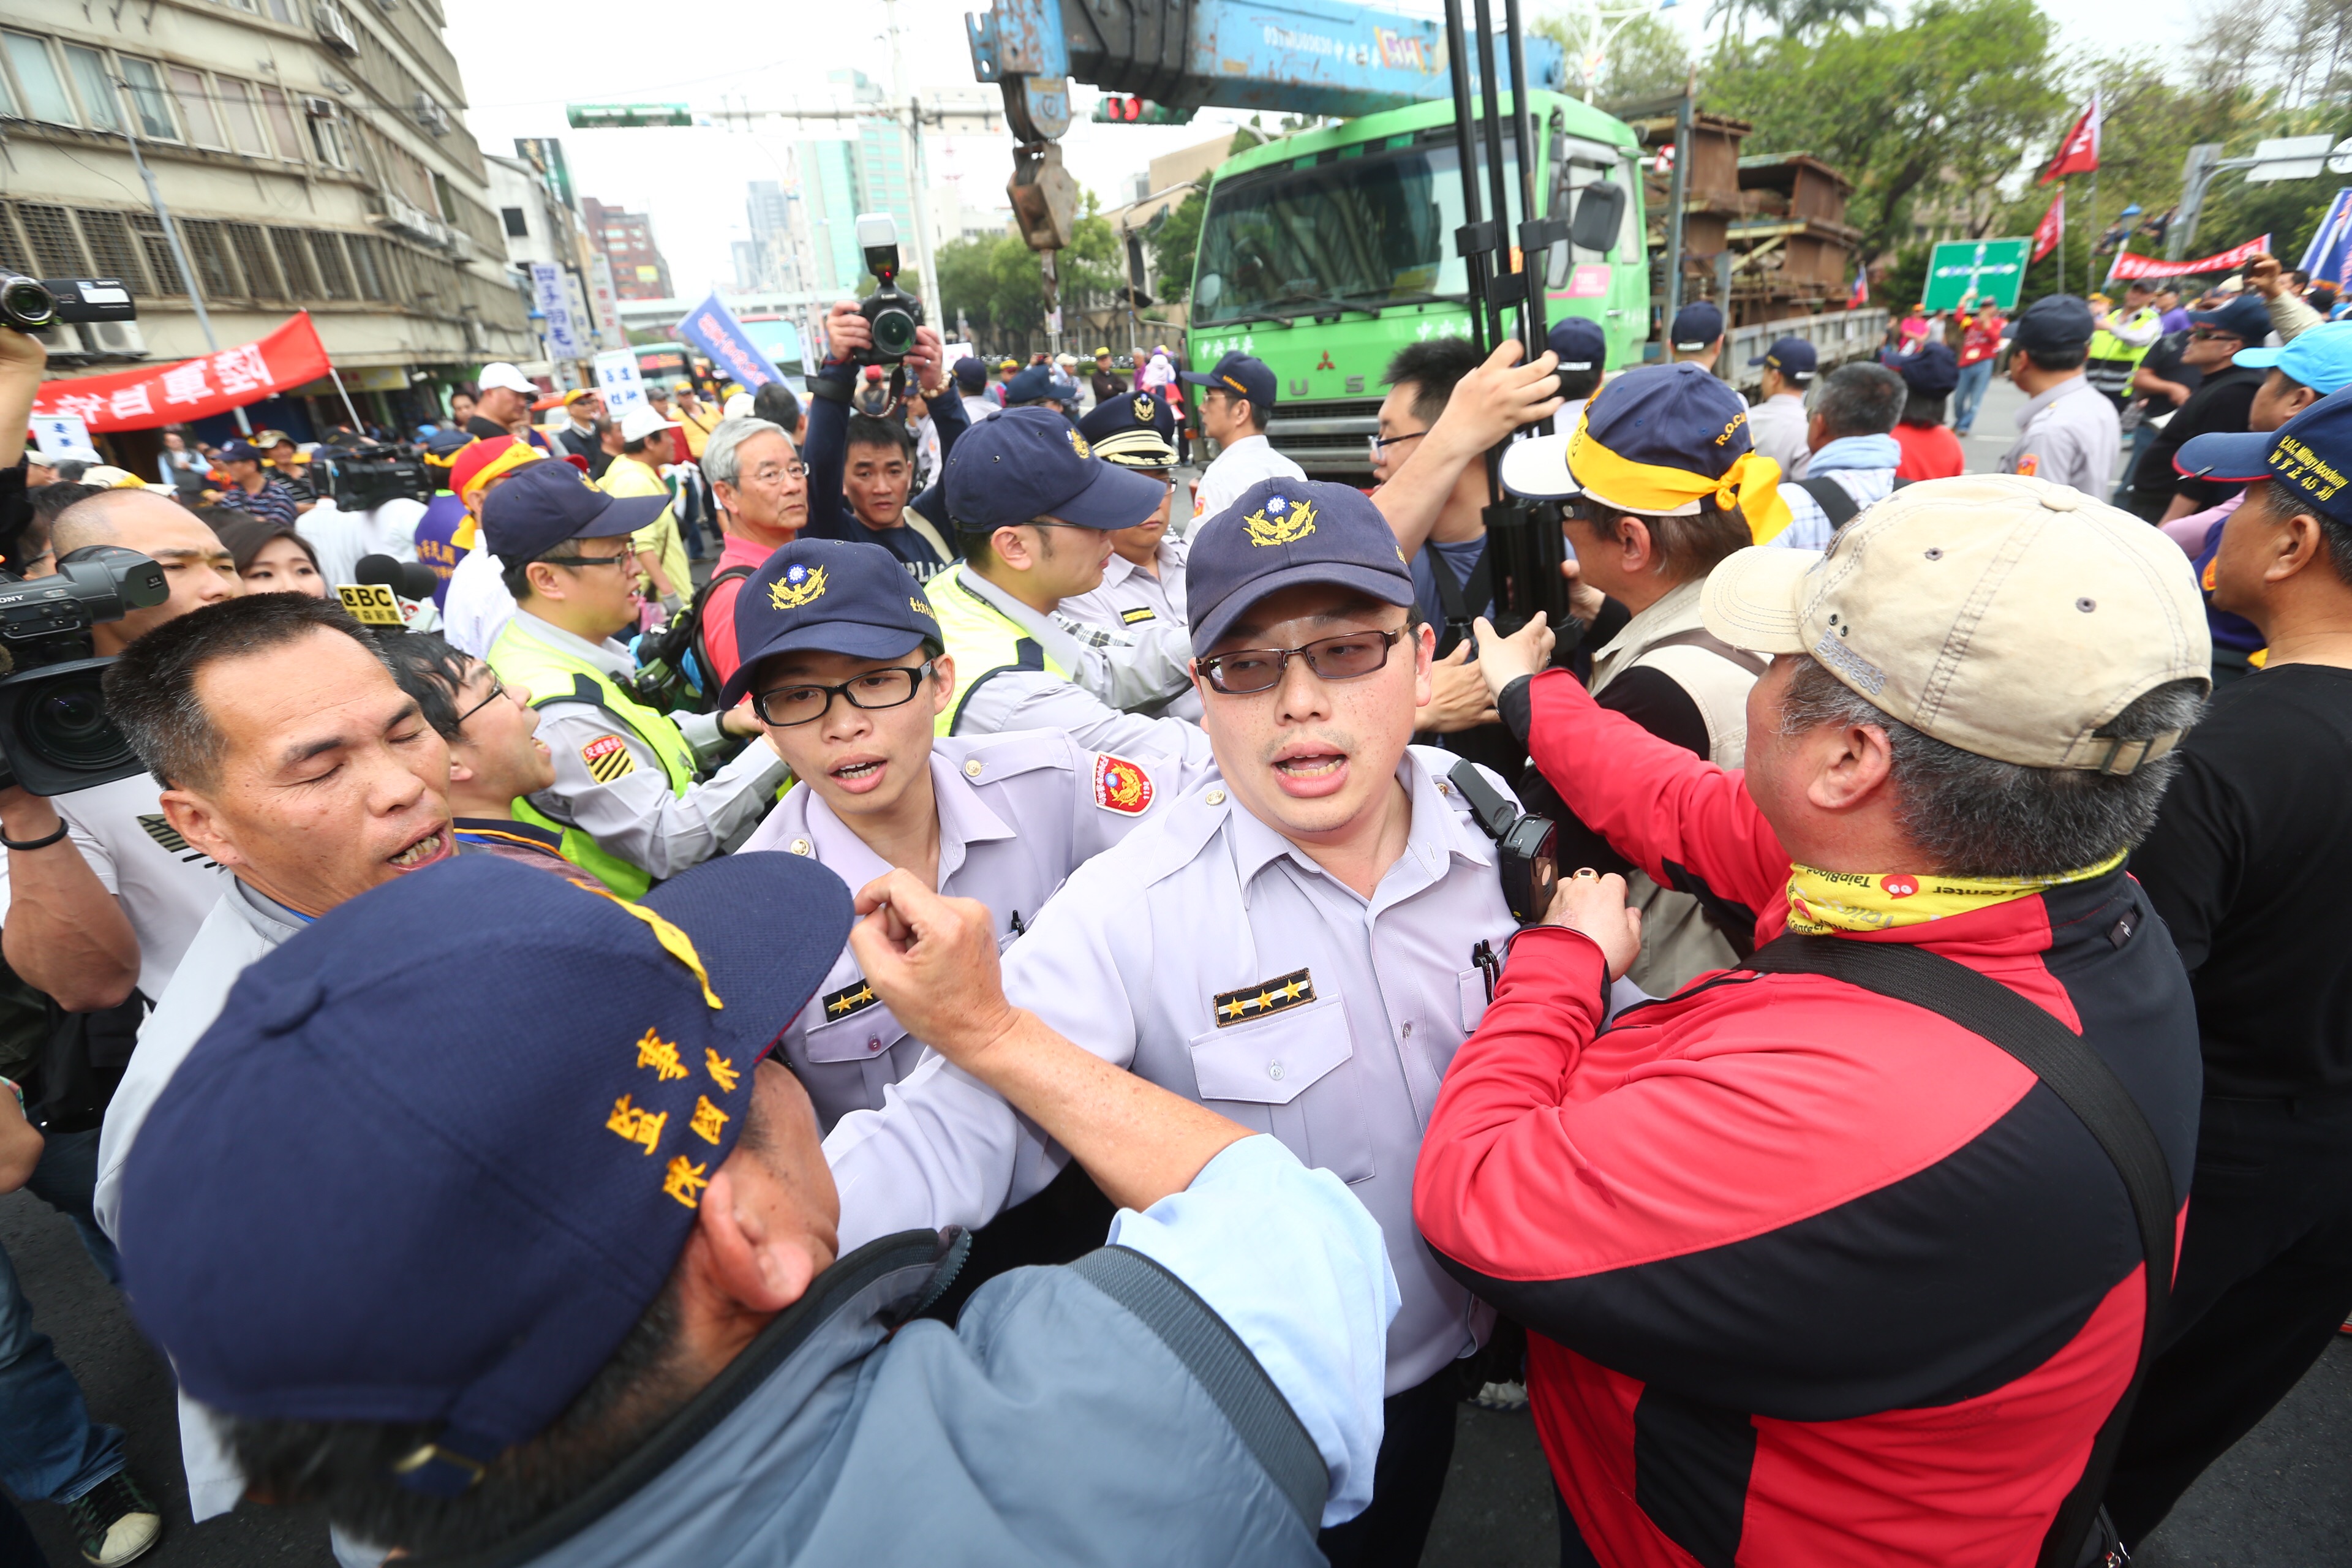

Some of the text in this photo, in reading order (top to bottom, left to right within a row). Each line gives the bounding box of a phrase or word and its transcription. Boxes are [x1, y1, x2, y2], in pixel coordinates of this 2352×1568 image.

[2310, 460, 2350, 491] Academy
[0, 595, 24, 604] ONY
[339, 588, 392, 607] EBC
[1814, 639, 1881, 696] Express
